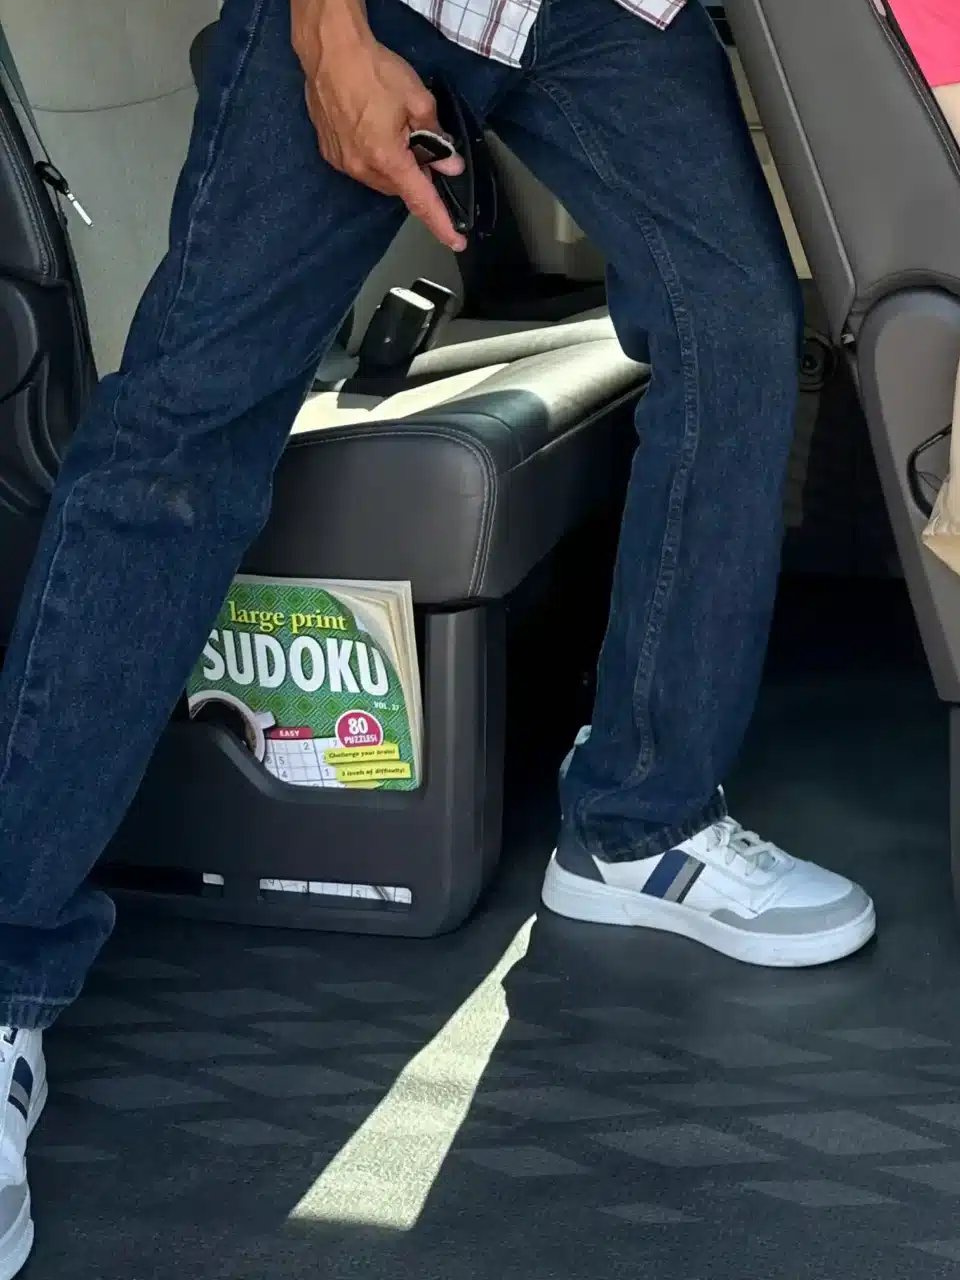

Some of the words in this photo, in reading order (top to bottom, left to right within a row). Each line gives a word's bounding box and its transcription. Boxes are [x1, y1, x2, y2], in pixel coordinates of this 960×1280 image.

[230, 601, 285, 632] large
[291, 609, 347, 633] print
[203, 628, 389, 696] SUDOKU
[348, 716, 368, 734] 80
[279, 729, 300, 737] EASY
[344, 734, 378, 745] PUZZLES!
[303, 742, 310, 750] 2
[279, 756, 285, 765] 5
